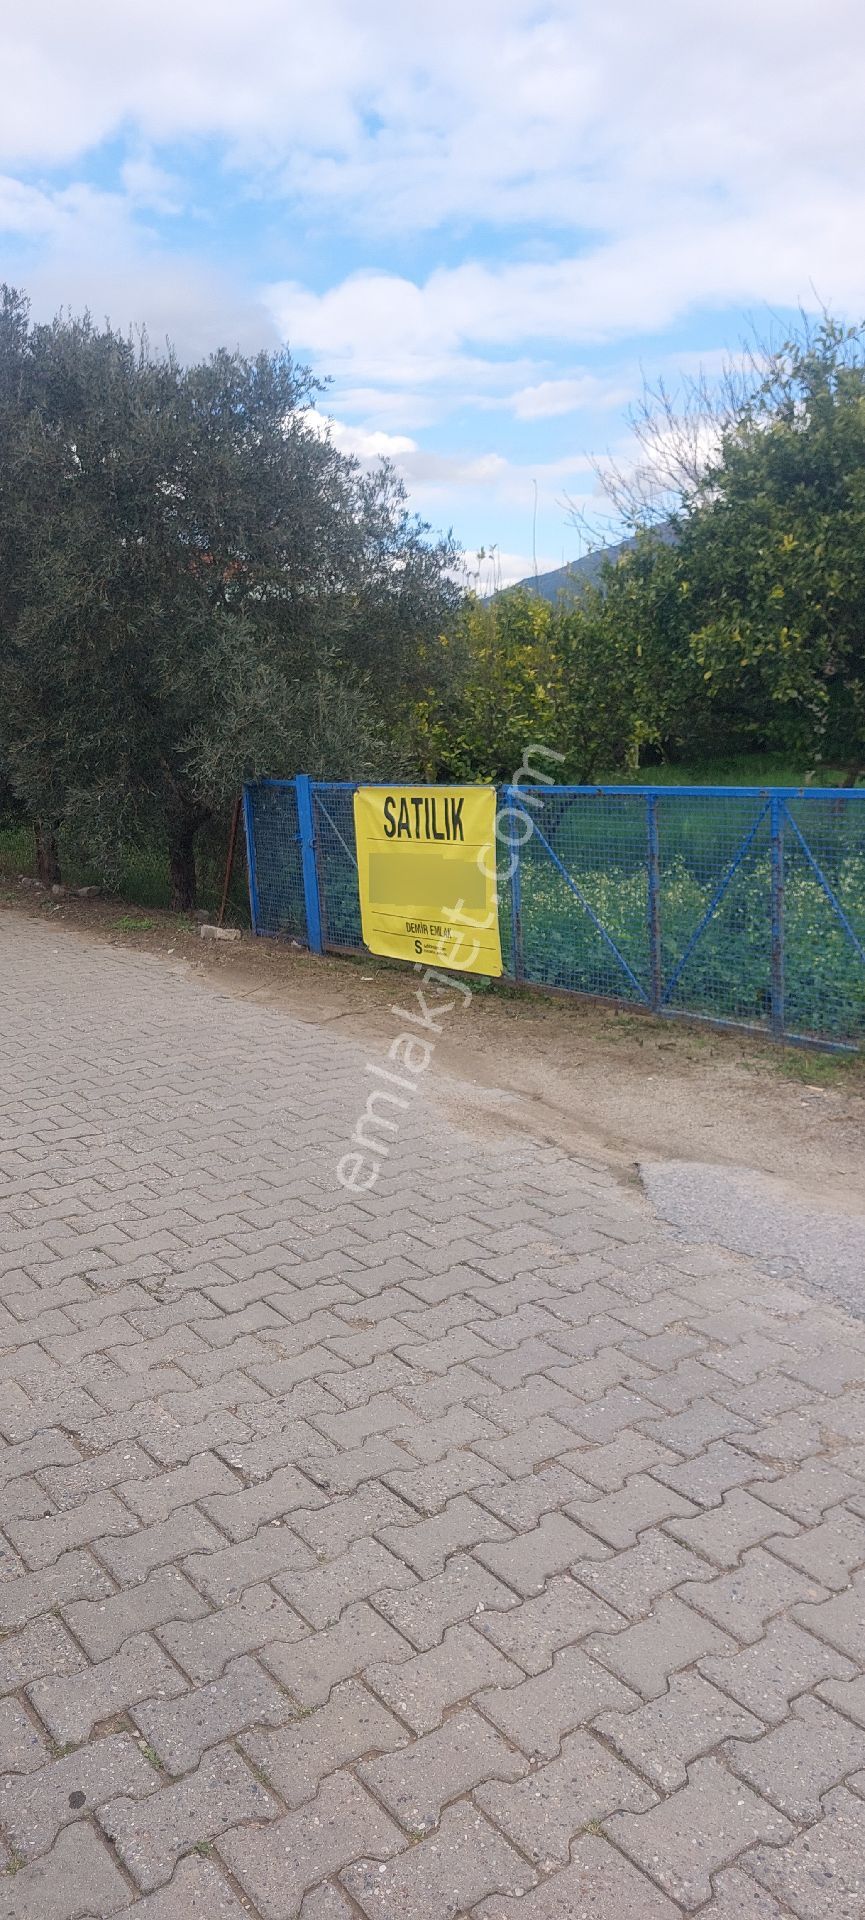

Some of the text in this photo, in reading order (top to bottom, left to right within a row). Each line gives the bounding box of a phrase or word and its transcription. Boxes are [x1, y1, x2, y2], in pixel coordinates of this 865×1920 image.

[383, 796, 464, 841] SATILIK
[405, 921, 452, 939] DEMİR EMLAK
